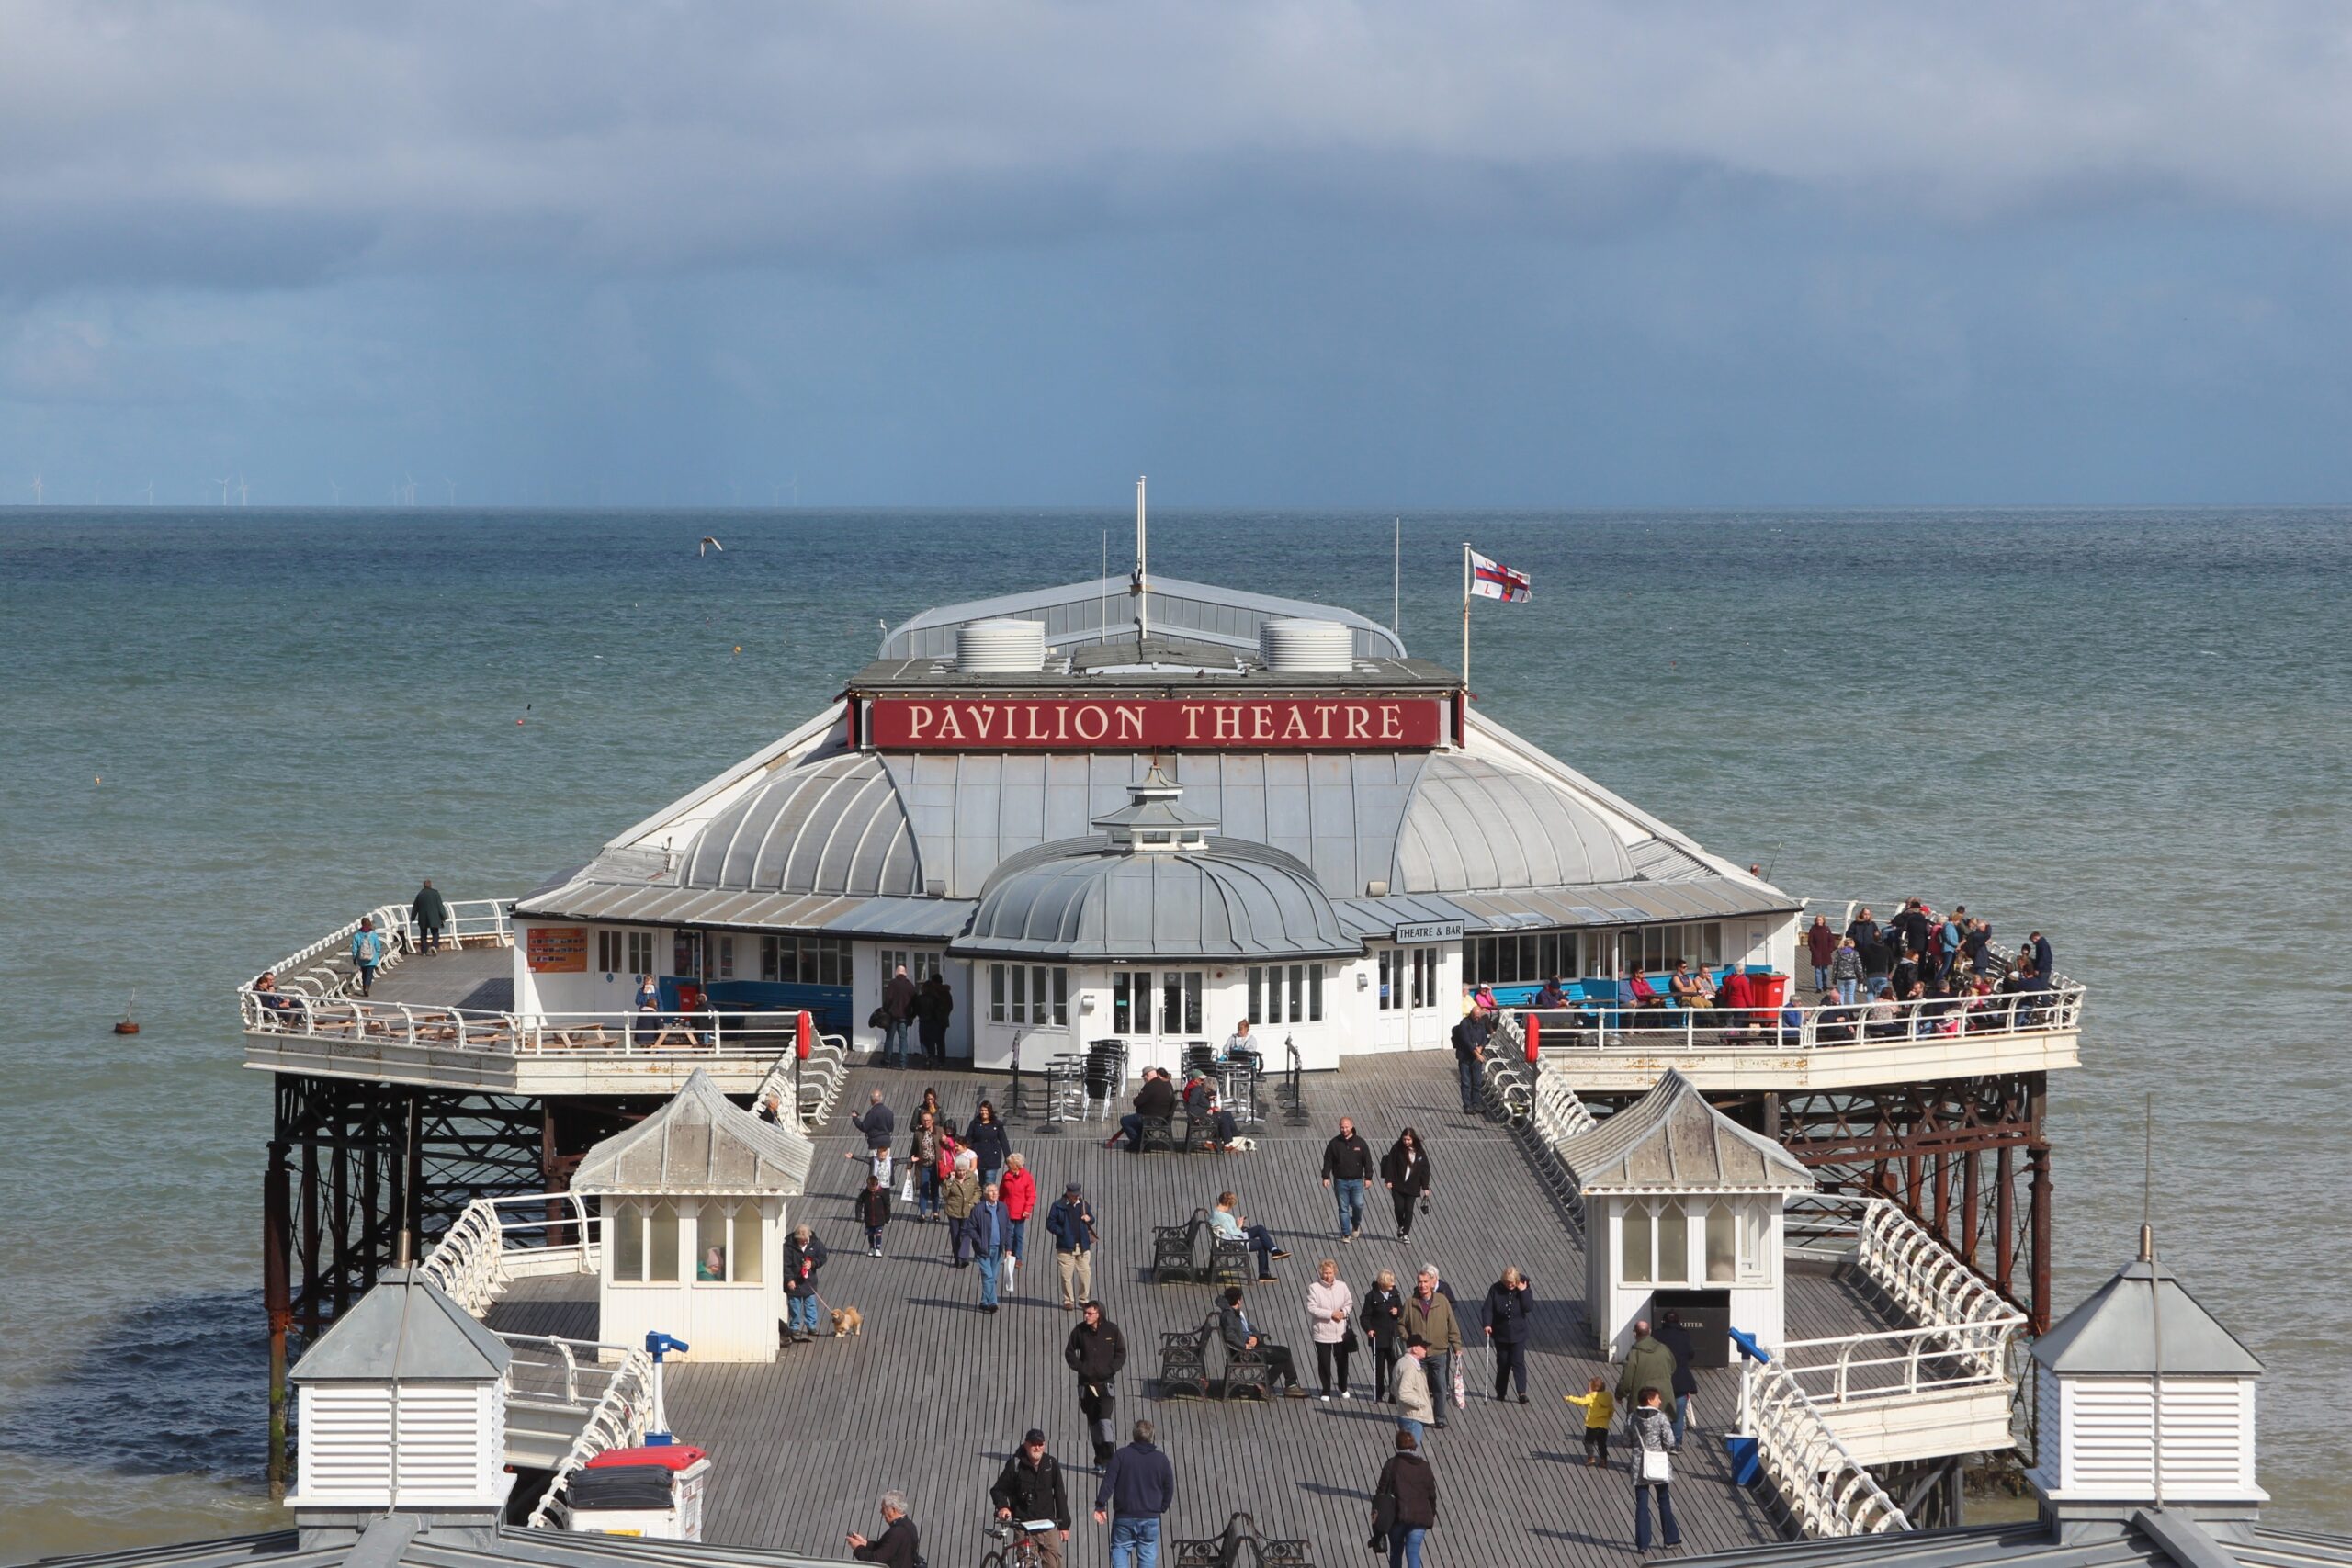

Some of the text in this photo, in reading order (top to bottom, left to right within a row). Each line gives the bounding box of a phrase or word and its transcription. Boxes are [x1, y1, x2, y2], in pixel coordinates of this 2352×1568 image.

[908, 705, 1404, 740] PAVILION THEATRE
[1399, 925, 1461, 938] THEATRE & BAR
